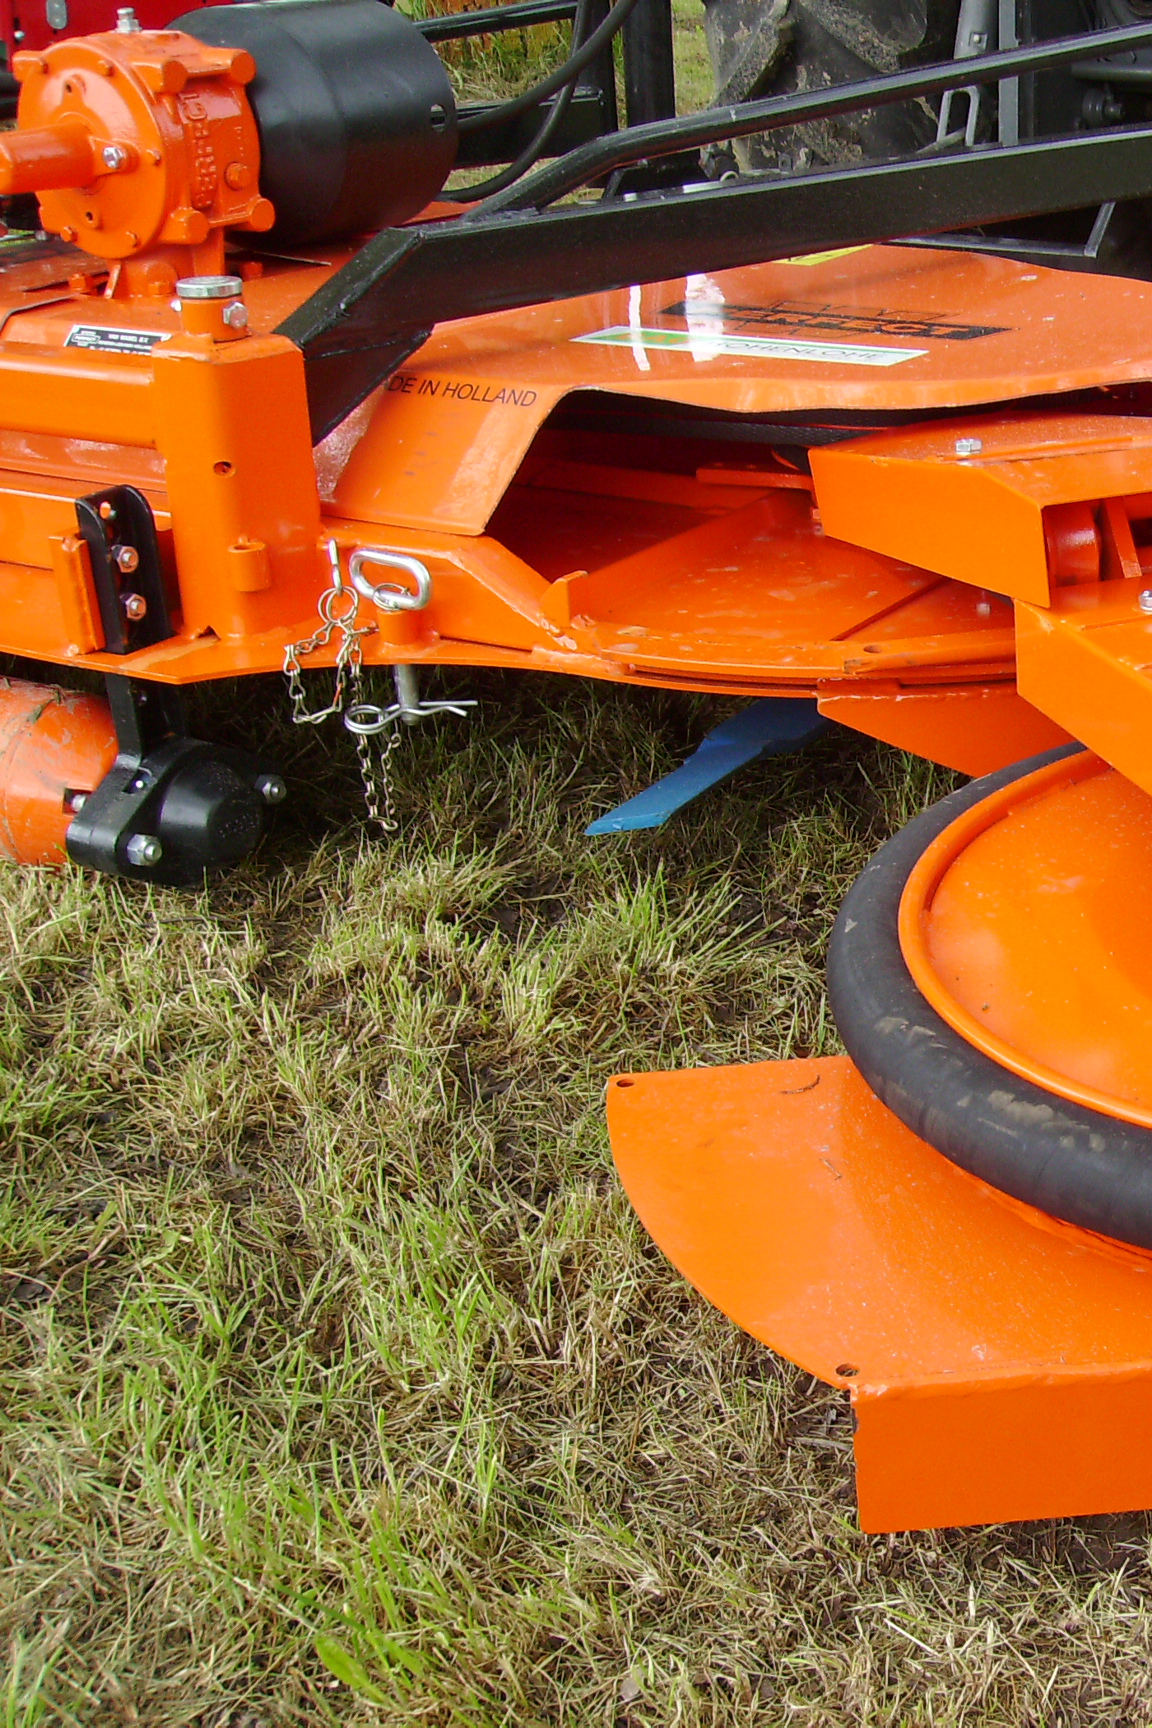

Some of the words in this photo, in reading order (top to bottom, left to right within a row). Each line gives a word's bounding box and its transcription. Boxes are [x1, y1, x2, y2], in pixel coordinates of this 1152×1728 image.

[712, 308, 971, 336] ERFECT
[385, 375, 417, 394] DE
[418, 379, 441, 396] IN
[442, 381, 537, 407] HOLLAND
